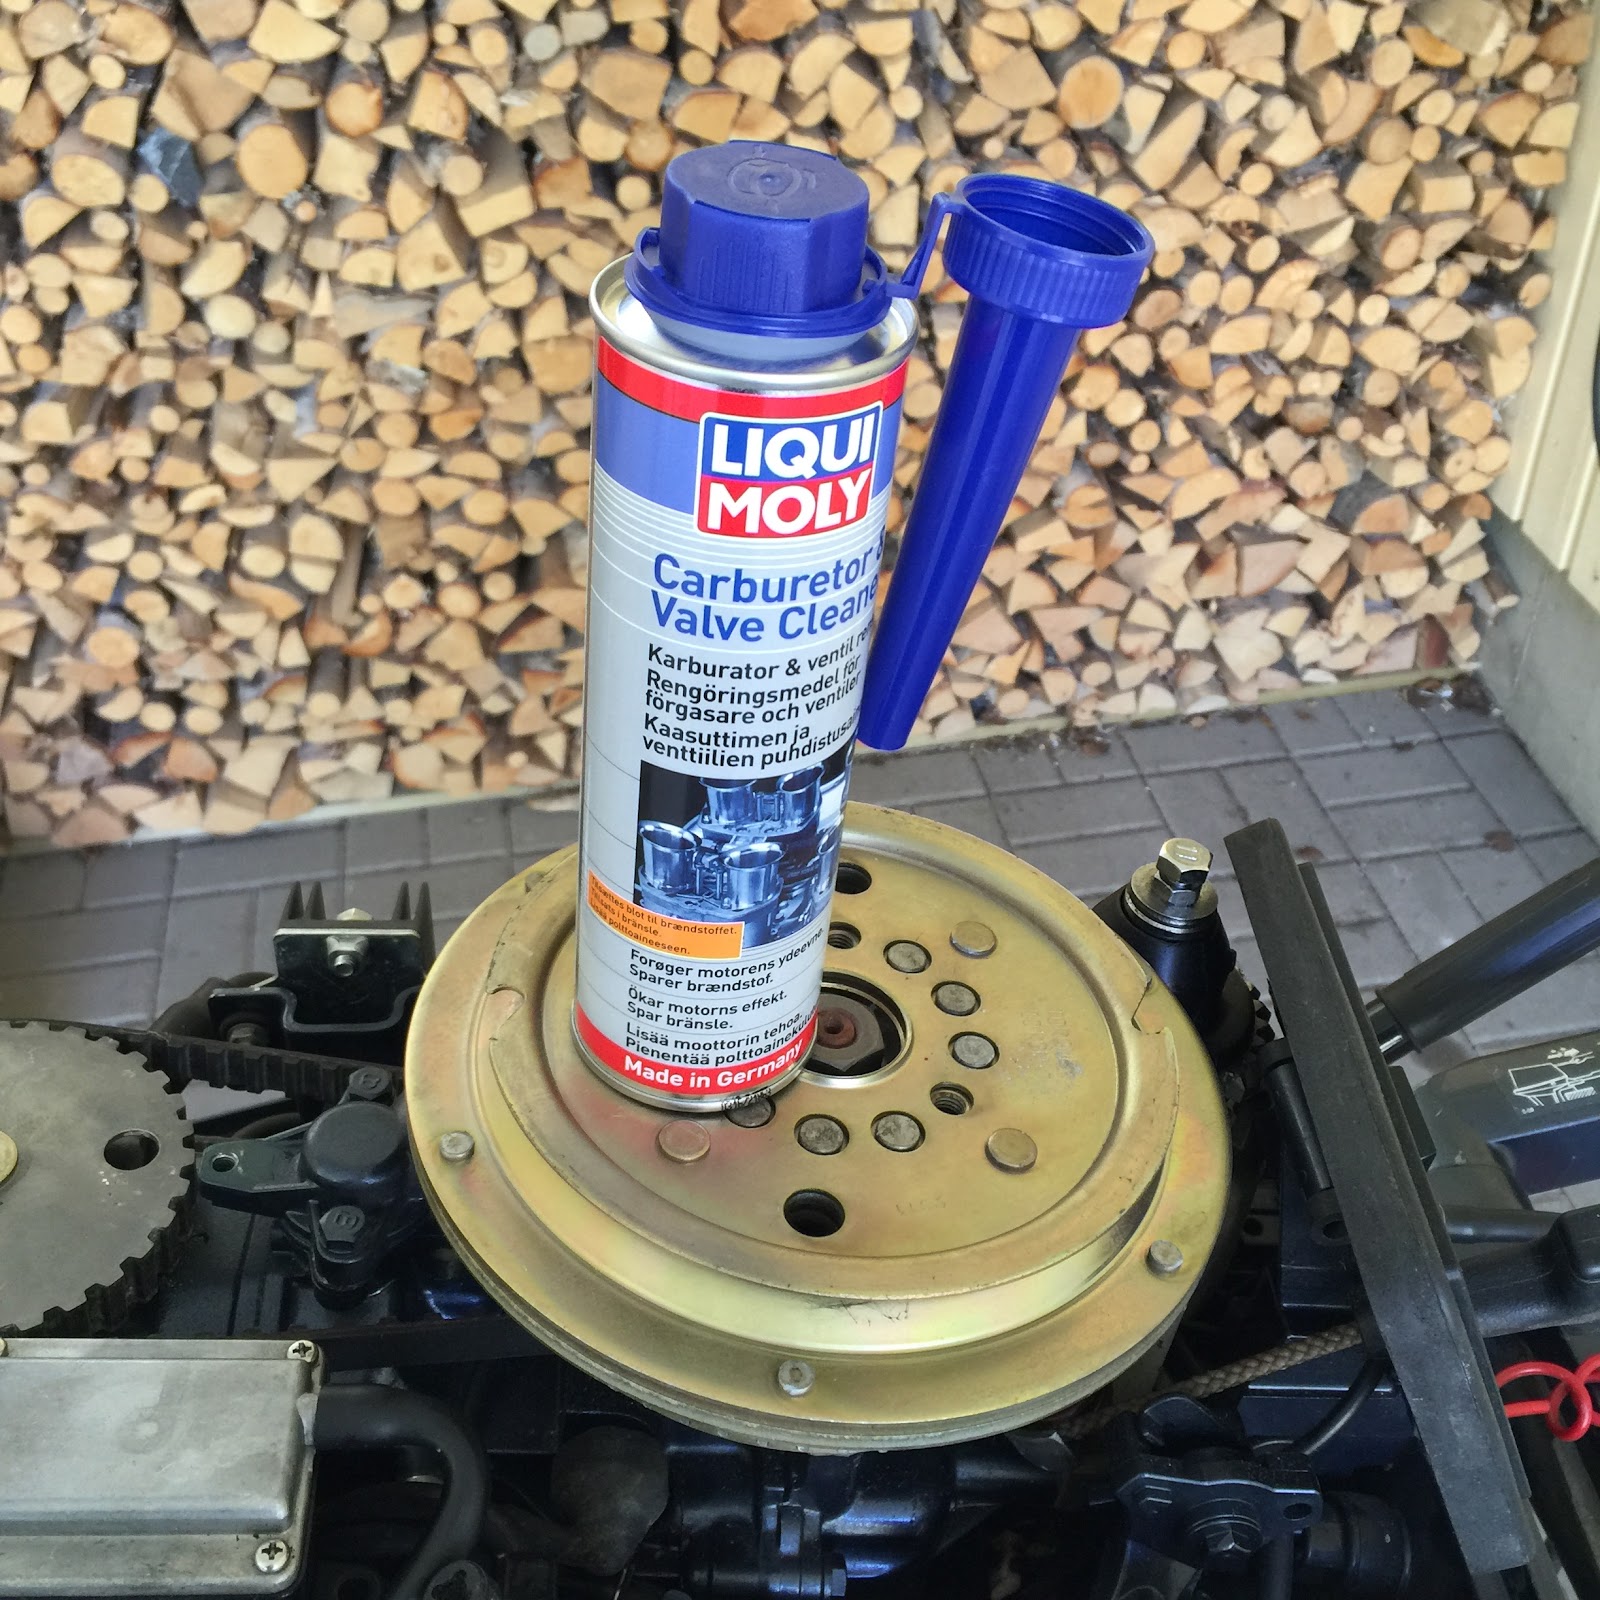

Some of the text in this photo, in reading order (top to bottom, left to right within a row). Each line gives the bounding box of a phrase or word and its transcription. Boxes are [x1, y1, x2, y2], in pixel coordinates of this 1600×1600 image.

[711, 413, 876, 480] LIQUI
[707, 468, 872, 534] MOLY
[654, 546, 873, 604] Carburetor
[651, 589, 764, 642] Valve
[648, 643, 780, 680] Karburator
[785, 658, 801, 676] &
[807, 634, 854, 671] ventil
[645, 670, 862, 724] förgasare och ventiler
[647, 654, 861, 709] Rengöringsmedel för
[644, 713, 810, 749] Kaasuttimen ja
[643, 735, 754, 767] venttiilien
[608, 918, 691, 955] polttoaineeseen.
[622, 913, 662, 937] bränsle.
[626, 905, 644, 920] blot
[647, 915, 657, 925] til
[660, 920, 737, 935] brændstoffet.
[629, 964, 774, 993] Sparer brændstof.
[630, 948, 694, 977] Forøger
[698, 960, 776, 979] motorens
[627, 1001, 733, 1030] Spar bränsle.
[628, 984, 788, 1016] Ökar motorns effekt.
[626, 1037, 710, 1065] Pienentää
[627, 1022, 669, 1047] Lisää
[674, 1033, 760, 1051] moottorin
[624, 1038, 804, 1088] Made in Germany
